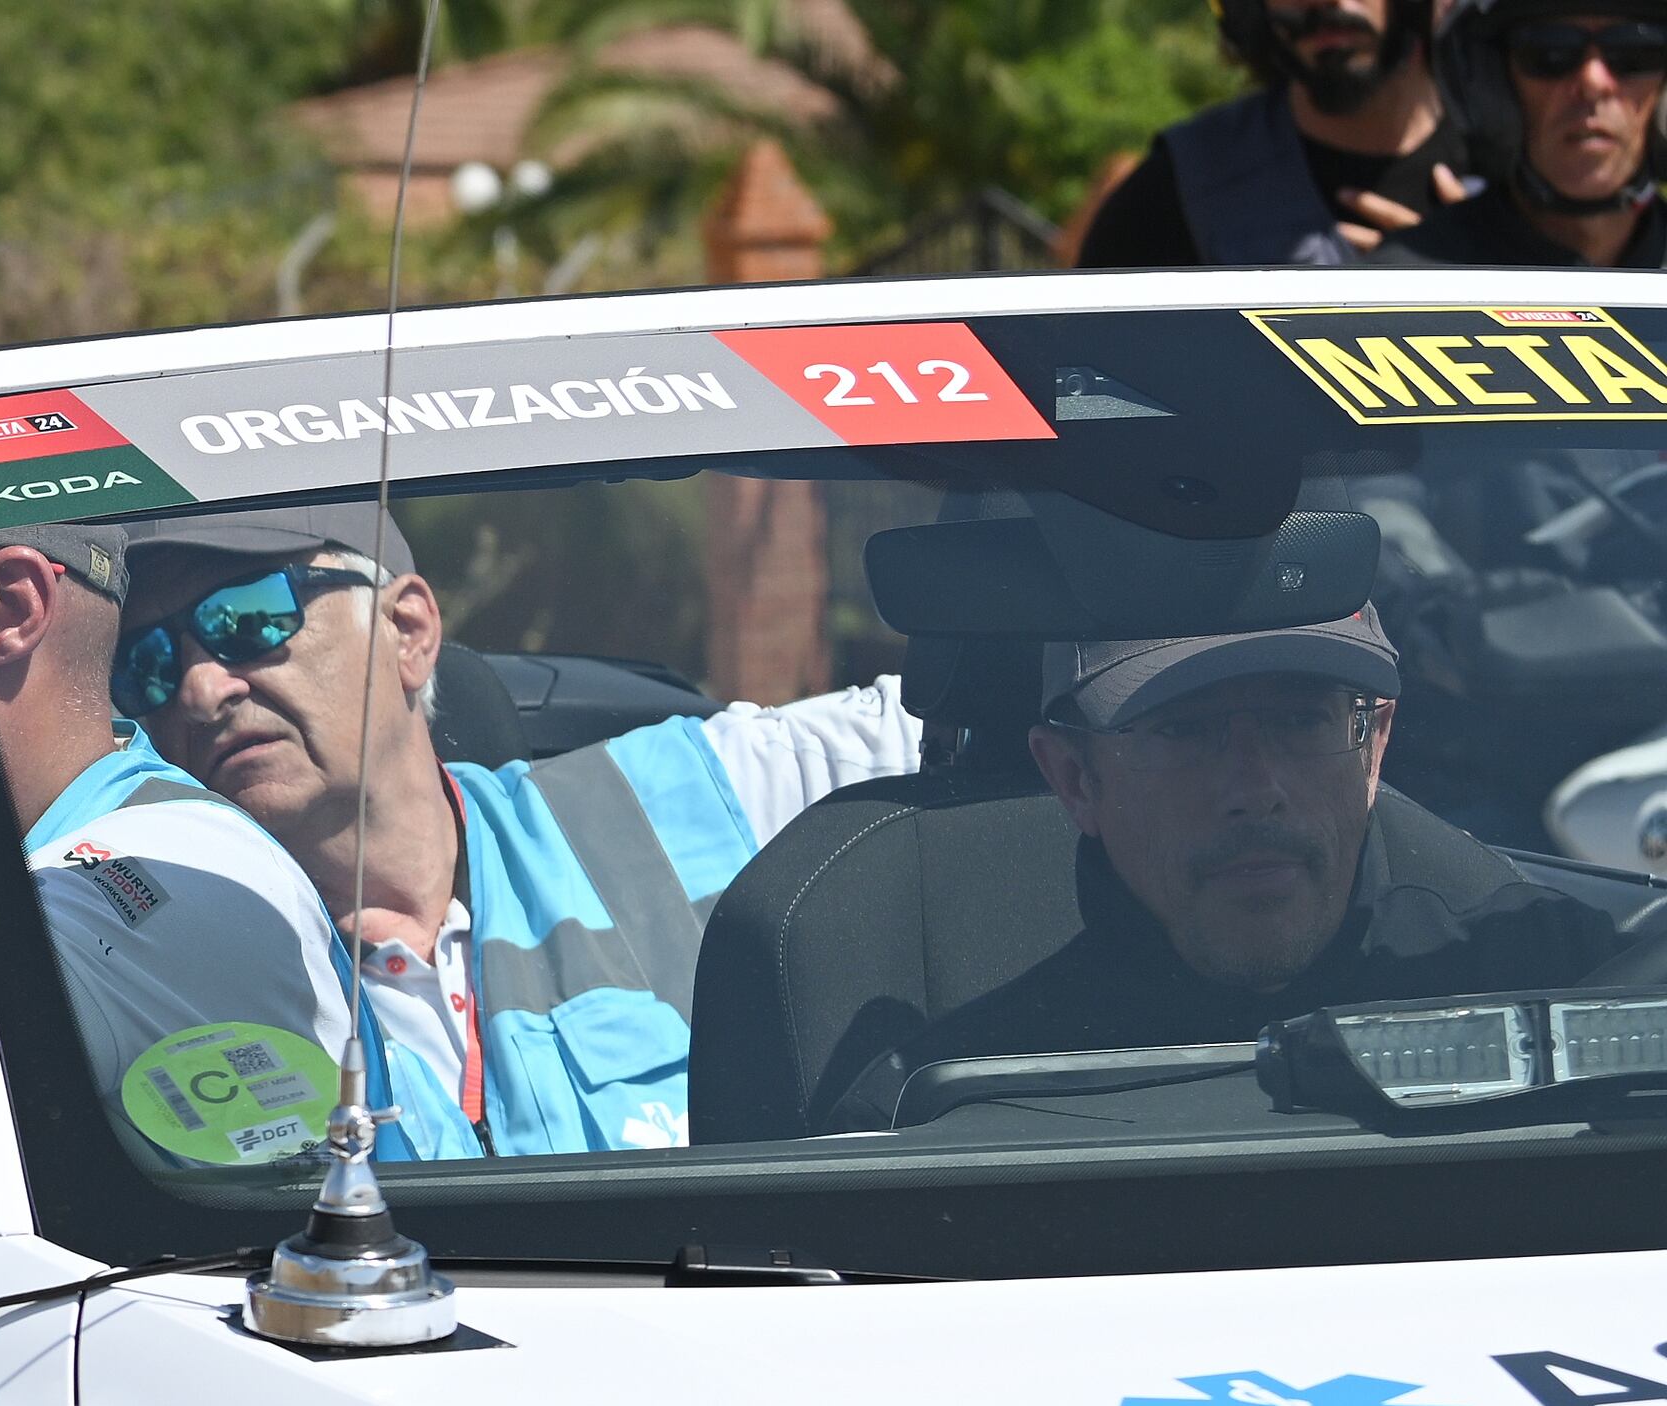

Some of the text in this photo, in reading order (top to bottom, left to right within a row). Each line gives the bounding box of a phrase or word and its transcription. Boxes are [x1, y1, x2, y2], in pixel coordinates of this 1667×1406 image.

[1576, 311, 1599, 322] 24
[803, 359, 990, 407] 212
[1295, 335, 1667, 408] META
[34, 415, 64, 432] 24
[179, 366, 738, 455] ORGANIZACIÓN
[92, 875, 137, 922] WORKWEAR
[102, 867, 150, 912] MODYF
[190, 1070, 239, 1103] C
[262, 1121, 298, 1141] DGT
